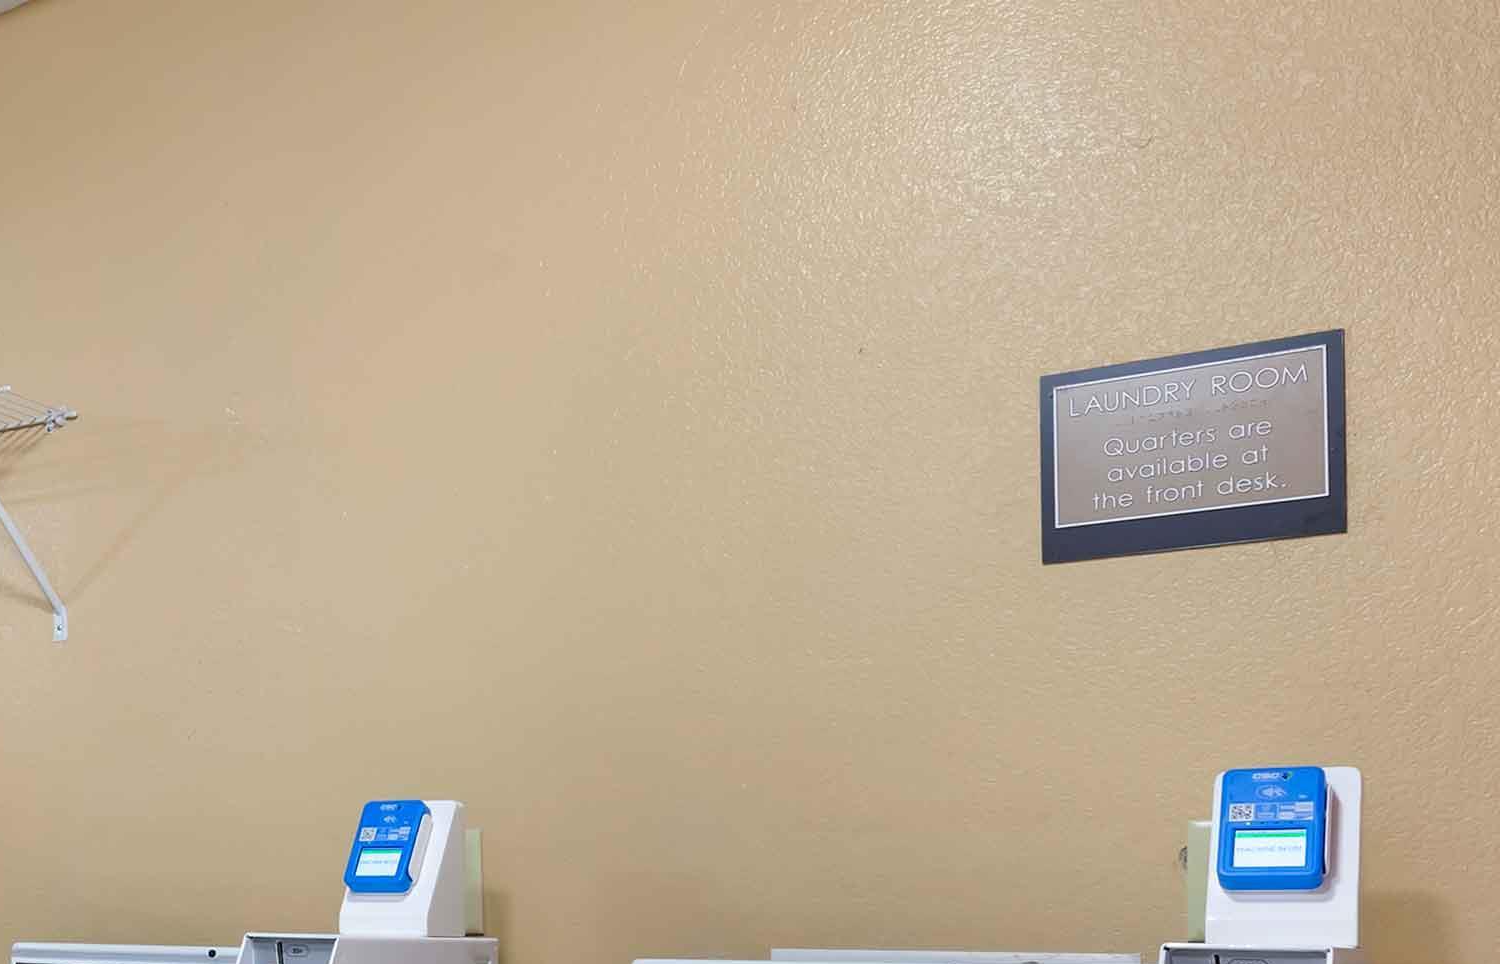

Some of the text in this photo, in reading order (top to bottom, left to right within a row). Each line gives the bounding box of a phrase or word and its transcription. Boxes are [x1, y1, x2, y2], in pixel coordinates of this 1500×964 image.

[1068, 363, 1309, 418] LAUNDRY ROOM
[1103, 419, 1273, 457] Quarters are
[1107, 444, 1269, 483] available at
[1092, 470, 1287, 512] the front desk.
